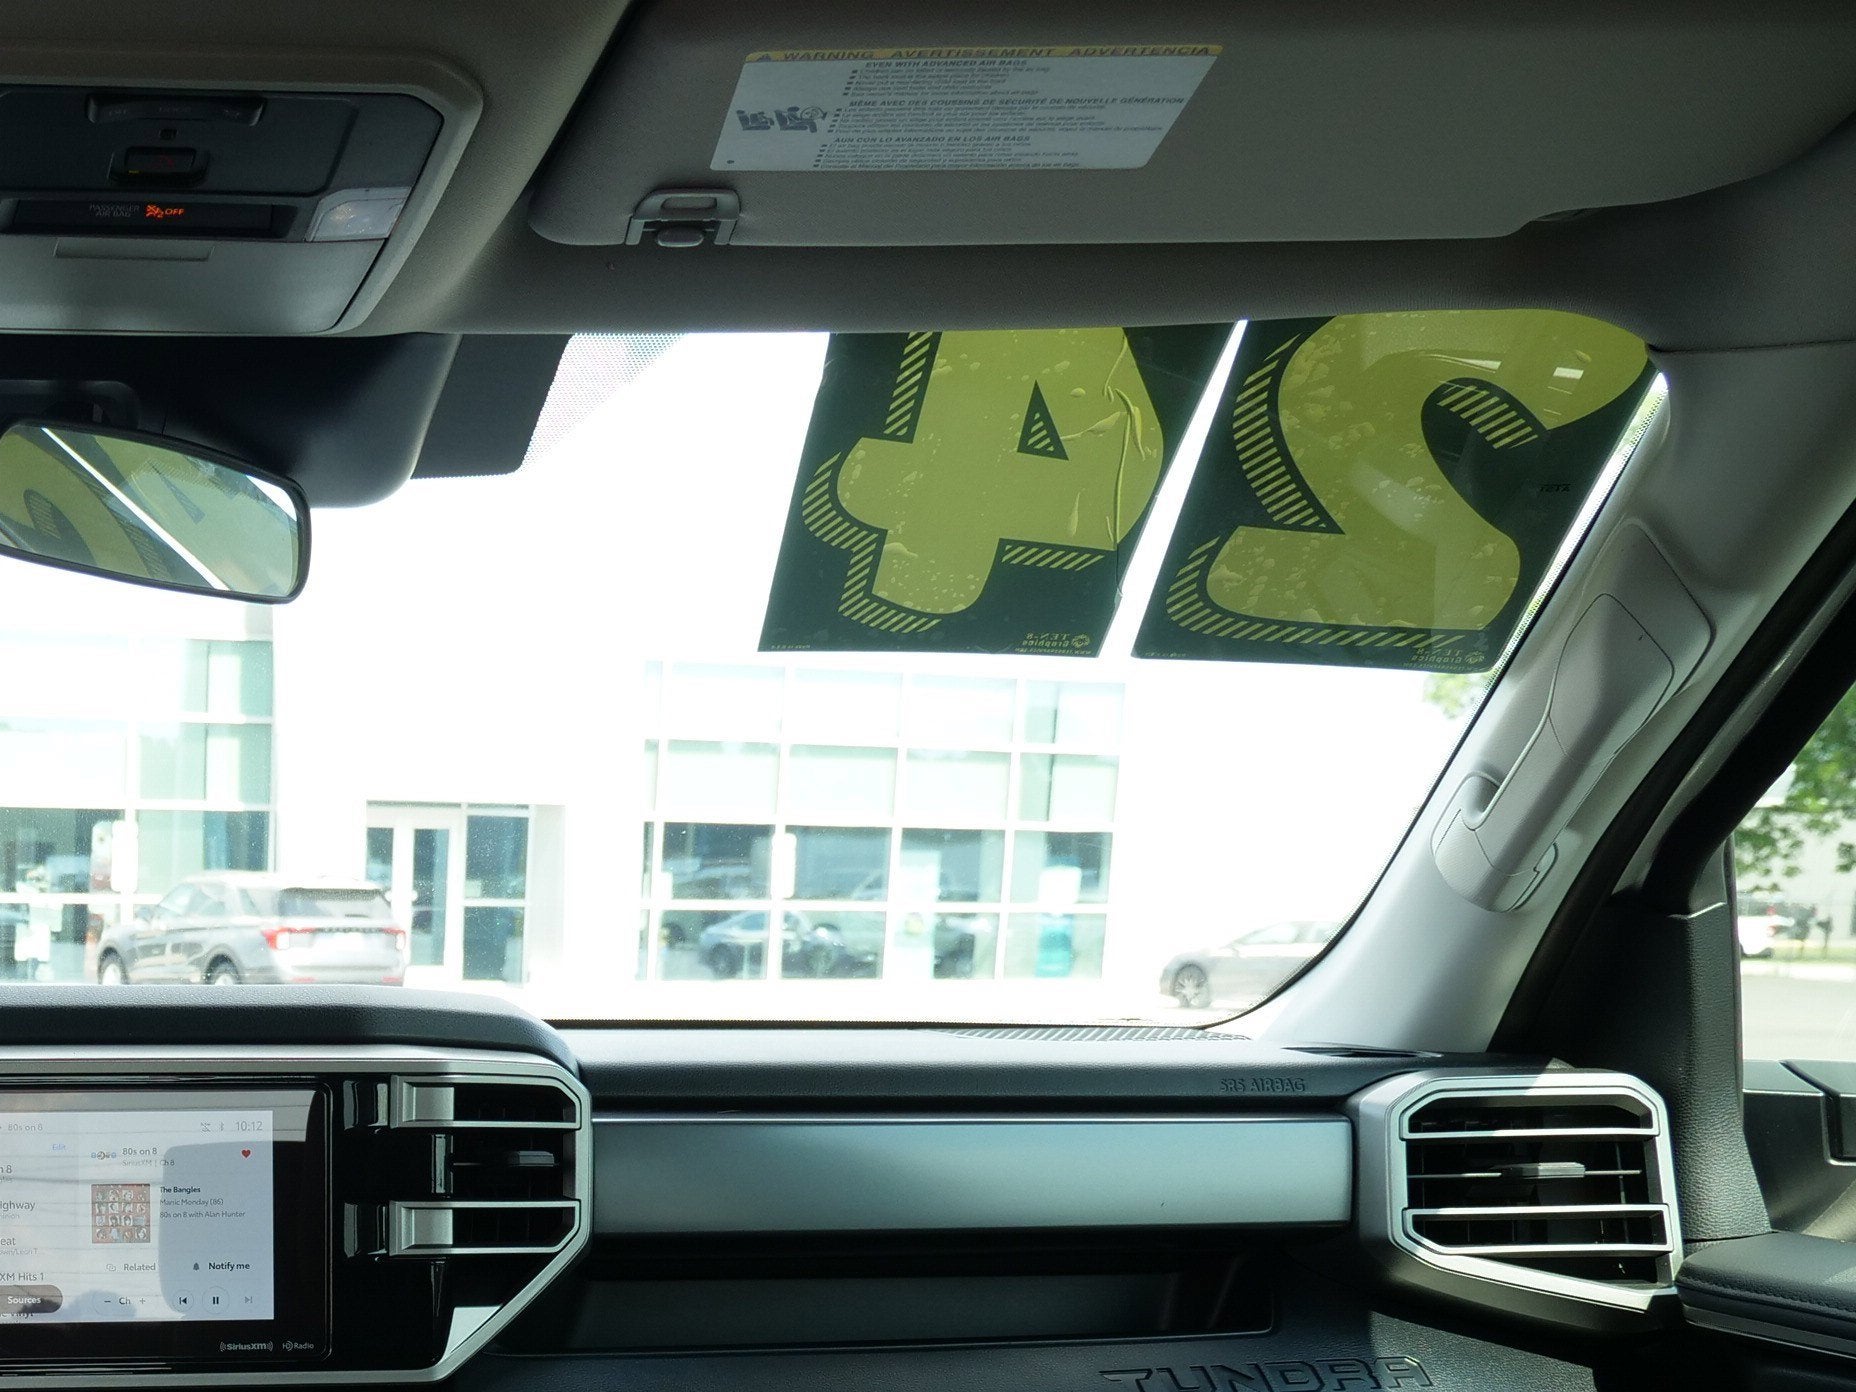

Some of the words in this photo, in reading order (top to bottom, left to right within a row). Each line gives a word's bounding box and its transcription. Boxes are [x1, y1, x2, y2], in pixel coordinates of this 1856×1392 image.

[783, 50, 874, 60] WARNING
[891, 48, 1056, 58] AVERTISSEMENT
[1069, 46, 1210, 56] ADVERTENCIA
[865, 60, 891, 68] EVEN
[895, 60, 919, 68] WITH
[921, 59, 976, 67] ADVANCED
[164, 208, 185, 216] OFF
[1220, 1077, 1245, 1092] SRS
[1249, 1077, 1306, 1092] AIRBAG
[7, 1123, 23, 1132] 80s
[37, 1123, 43, 1131] 8
[235, 1121, 263, 1131] 10:12
[52, 1143, 67, 1151] Edit
[122, 1147, 137, 1155] 80s
[152, 1147, 157, 1155] 8
[6, 1164, 13, 1174] 8
[173, 1186, 200, 1194] Bangles
[181, 1198, 208, 1206] Monday
[208, 1262, 235, 1272] Notify
[18, 1272, 37, 1281] Hits
[7, 1296, 42, 1304] Sources
[118, 1297, 131, 1305] Ch
[294, 1342, 315, 1350] Radio
